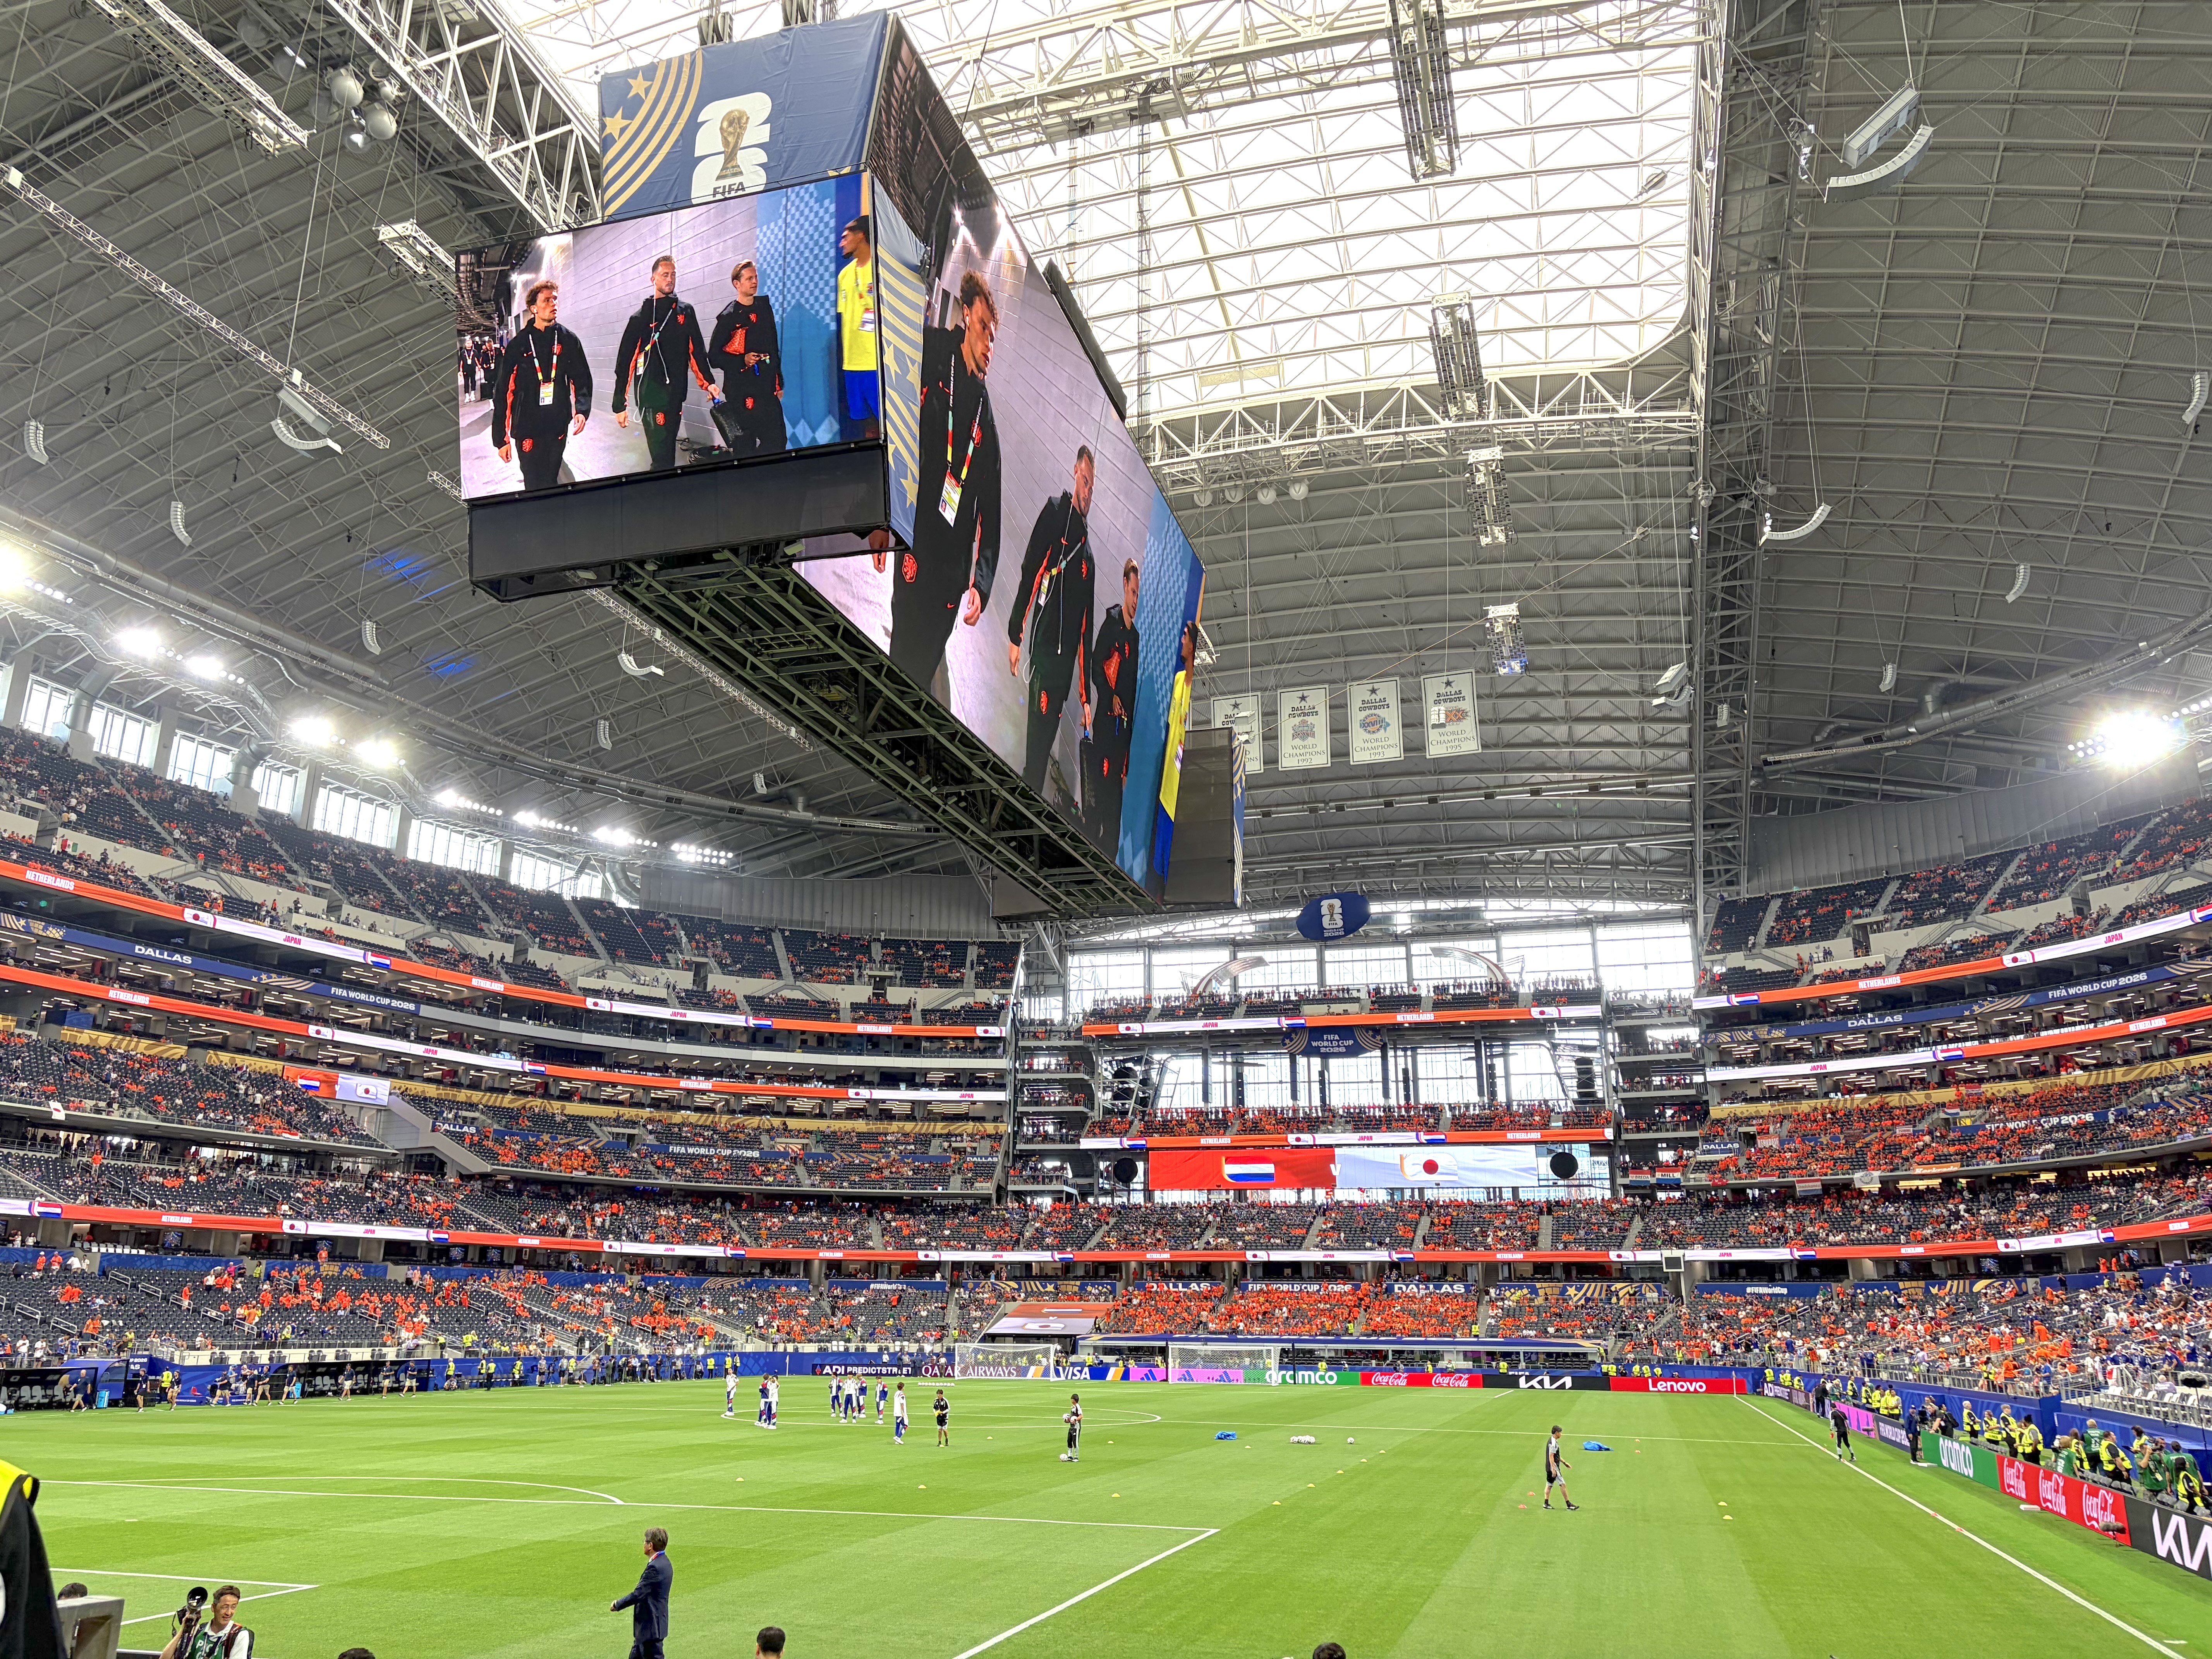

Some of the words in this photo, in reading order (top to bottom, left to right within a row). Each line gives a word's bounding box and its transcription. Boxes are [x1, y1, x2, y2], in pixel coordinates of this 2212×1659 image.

[713, 182, 746, 198] FIFA
[1436, 690, 1462, 698] DALLAS
[1434, 696, 1466, 705] COWBOYS
[1431, 736, 1475, 746] CHAMPIONS
[1355, 743, 1398, 752] CHAMPIONS
[1284, 750, 1325, 758] CHAMPIONS
[26, 870, 74, 890] NETHERLANDS
[283, 934, 301, 945] JAPAN
[2104, 933, 2123, 944] JAPAN
[135, 945, 192, 964] DALLAS
[472, 978, 504, 991] NETHERLANDS
[1859, 976, 1900, 989] NETHERLANDS
[2049, 989, 2067, 999] FIFA
[2068, 983, 2099, 996] WORLD
[2100, 979, 2118, 989] CUP
[2119, 973, 2147, 985] 2026
[109, 989, 149, 1005] NETHERLANDS
[331, 987, 347, 997] FIFA
[349, 990, 375, 1002] WORLD
[376, 996, 390, 1005] CUP
[391, 1000, 415, 1010] 2026
[1848, 1015, 1903, 1027] DALLAS
[2130, 1018, 2167, 1032] NETHERLANDS
[857, 1024, 893, 1034] NETHERLANDS
[423, 1047, 438, 1056] JAPAN
[687, 1146, 715, 1154] WORLD
[1746, 1286, 1788, 1295] #FIFAWorldCup
[823, 1365, 845, 1374] ADI
[922, 1365, 961, 1377] QAAR
[967, 1366, 1017, 1377] AIRWAYS
[1056, 1367, 1091, 1379] VISA
[1266, 1370, 1337, 1385] aramco
[1648, 1378, 1706, 1392] Lenovo
[1939, 1437, 1973, 1479] aramco
